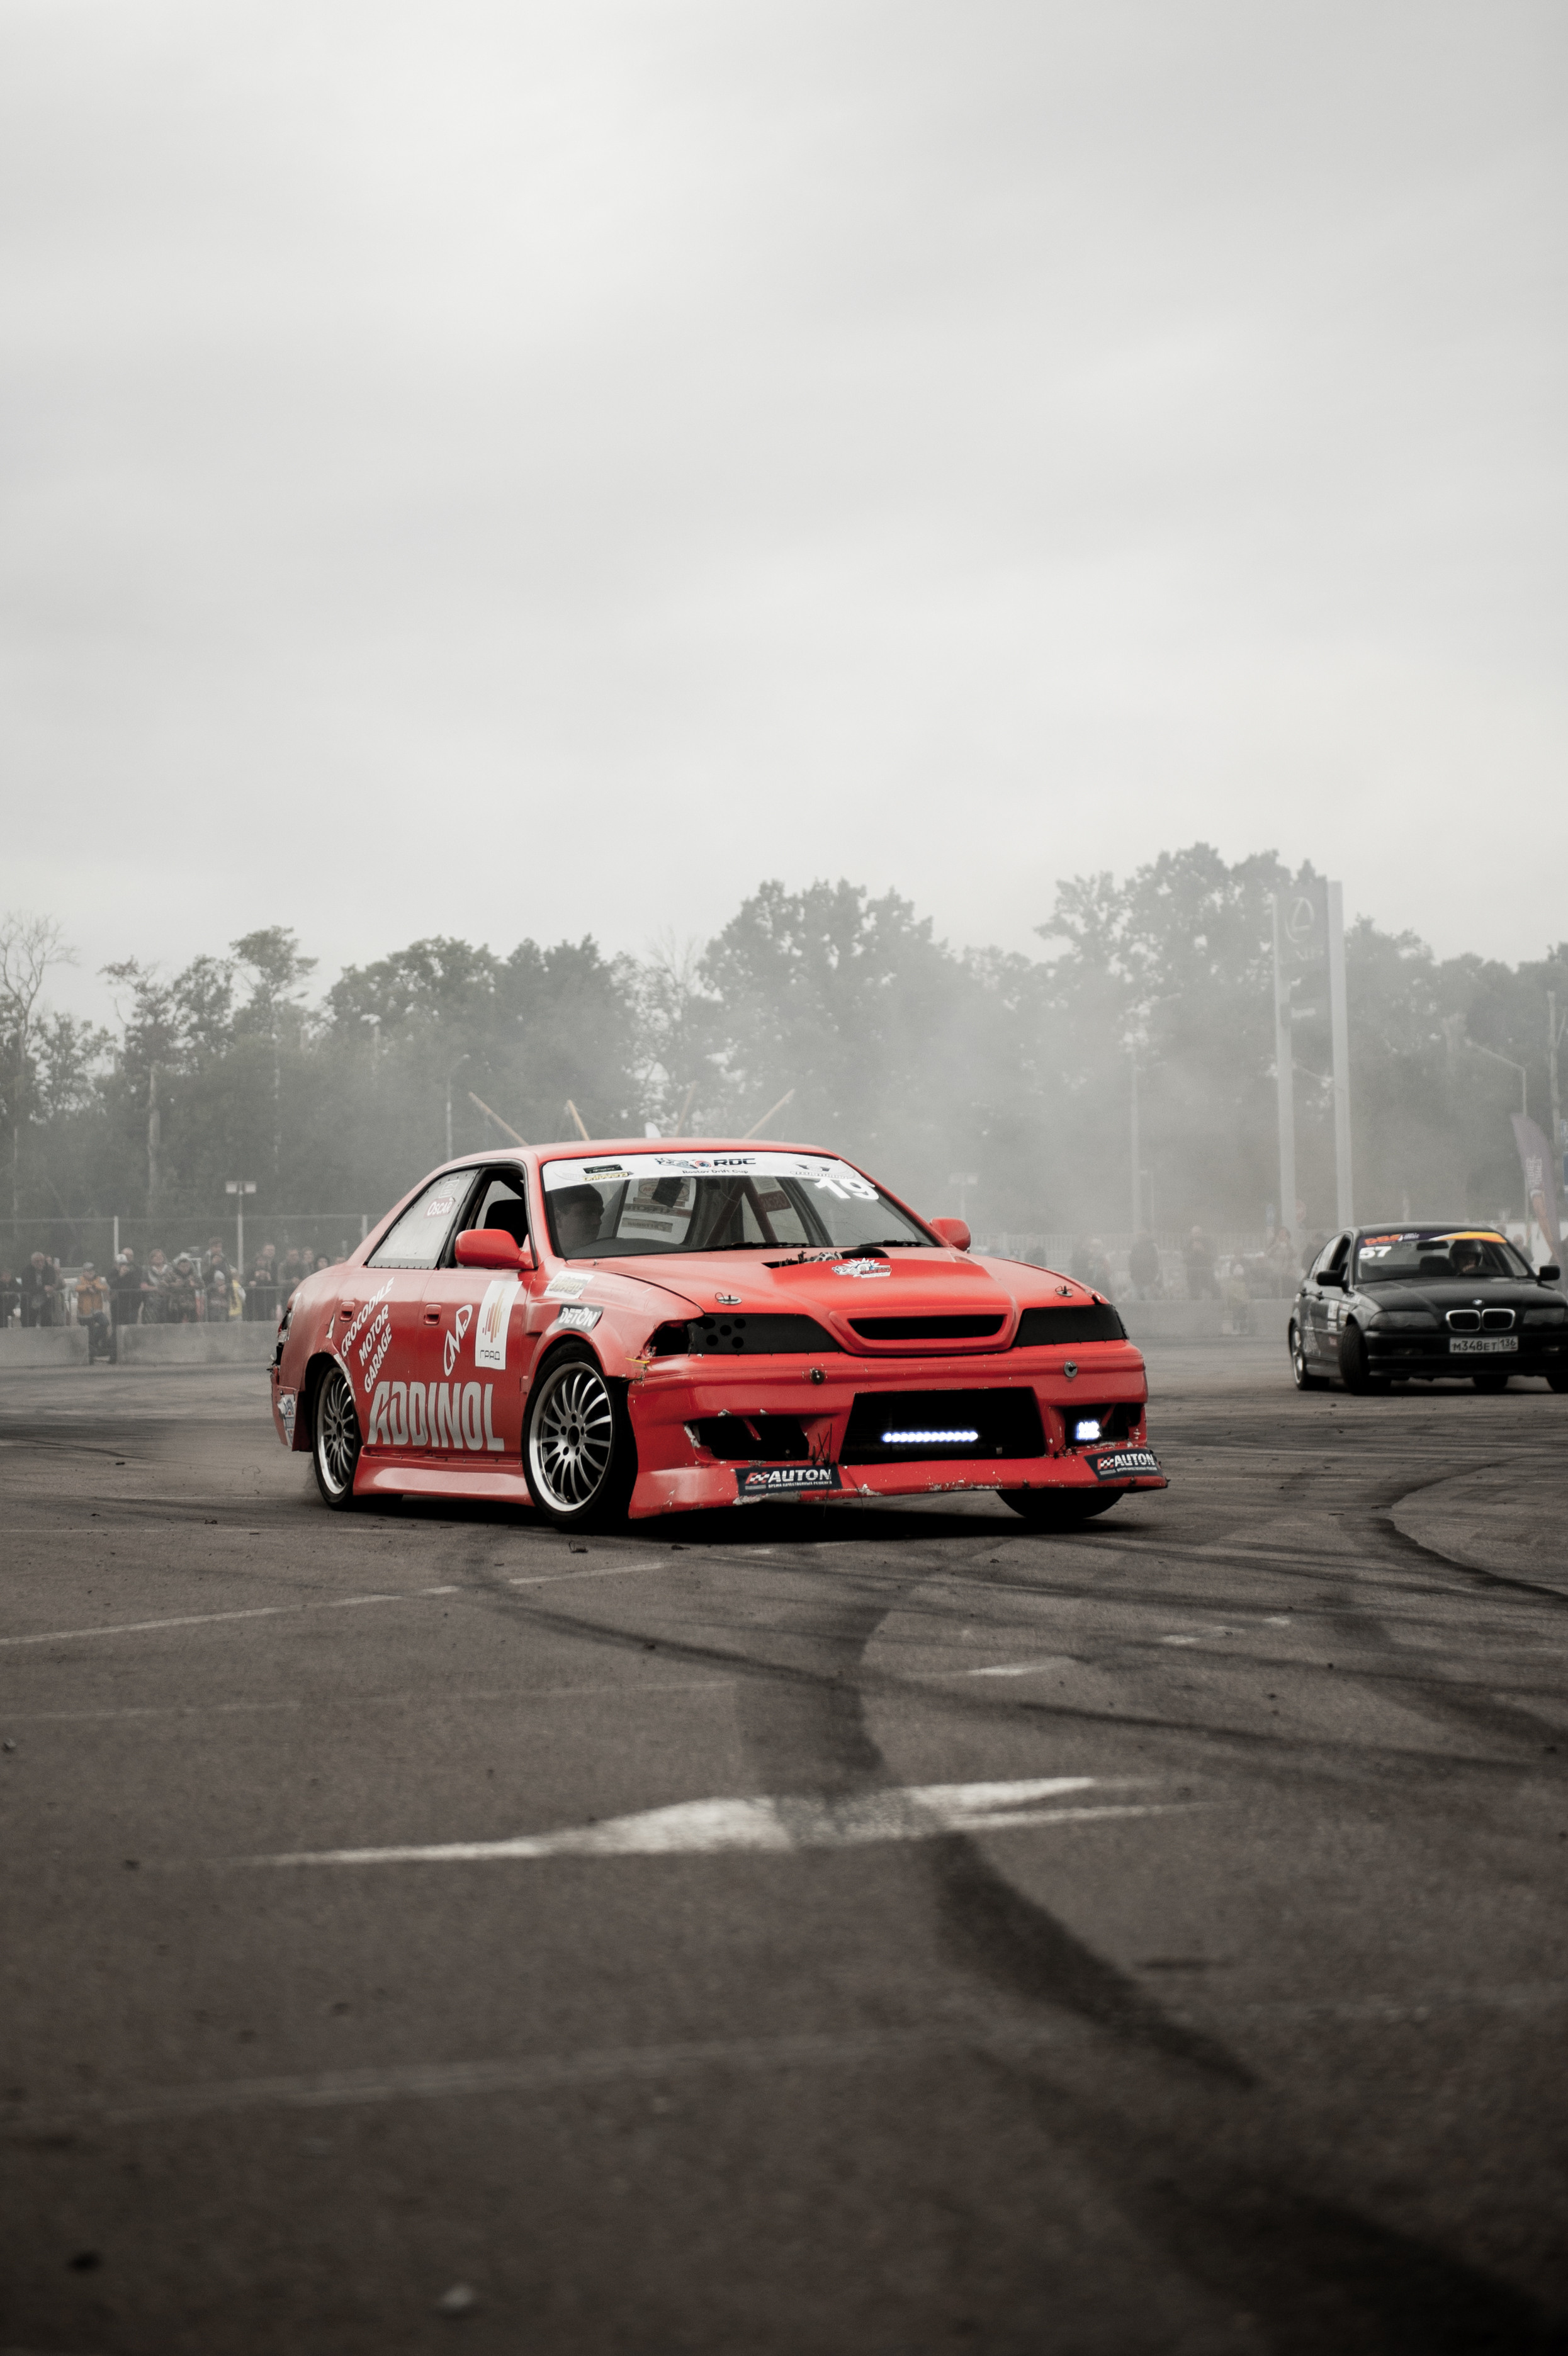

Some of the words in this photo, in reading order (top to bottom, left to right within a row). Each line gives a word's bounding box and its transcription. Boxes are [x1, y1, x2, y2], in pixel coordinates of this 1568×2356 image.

[713, 1158, 756, 1166] RDC
[814, 1177, 879, 1200] 19
[426, 1200, 453, 1217] OSCAR
[1358, 1246, 1392, 1260] 57
[341, 1277, 395, 1358] CROCODILE
[558, 1307, 598, 1327] DETON
[358, 1304, 389, 1367] MOTOR
[1500, 1338, 1516, 1346] 136
[364, 1323, 392, 1393] GARAGE
[366, 1380, 505, 1452] ADDINOL
[1115, 1453, 1156, 1467] AUTON
[767, 1469, 832, 1483] AUTON
